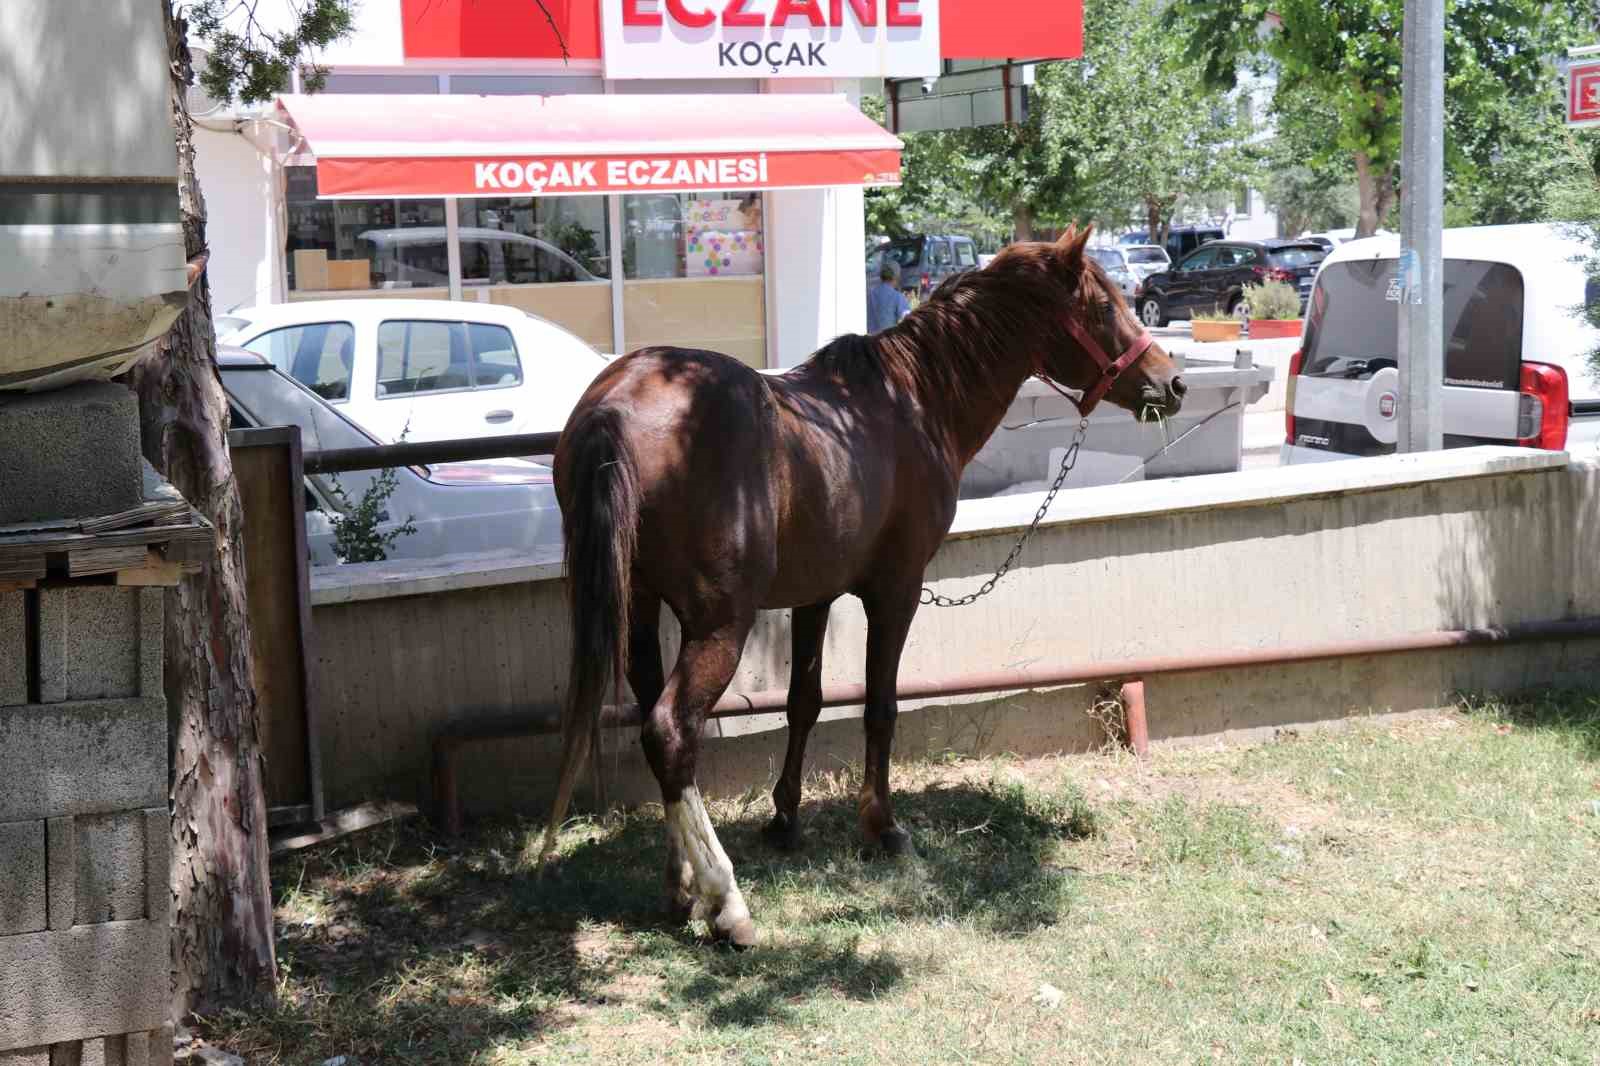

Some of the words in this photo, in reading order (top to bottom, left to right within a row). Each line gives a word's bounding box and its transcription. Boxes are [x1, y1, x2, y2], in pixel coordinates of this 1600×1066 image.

[718, 40, 827, 74] KOÇAK
[474, 160, 598, 193] KOÇAK
[607, 153, 769, 186] ECZANESİ
